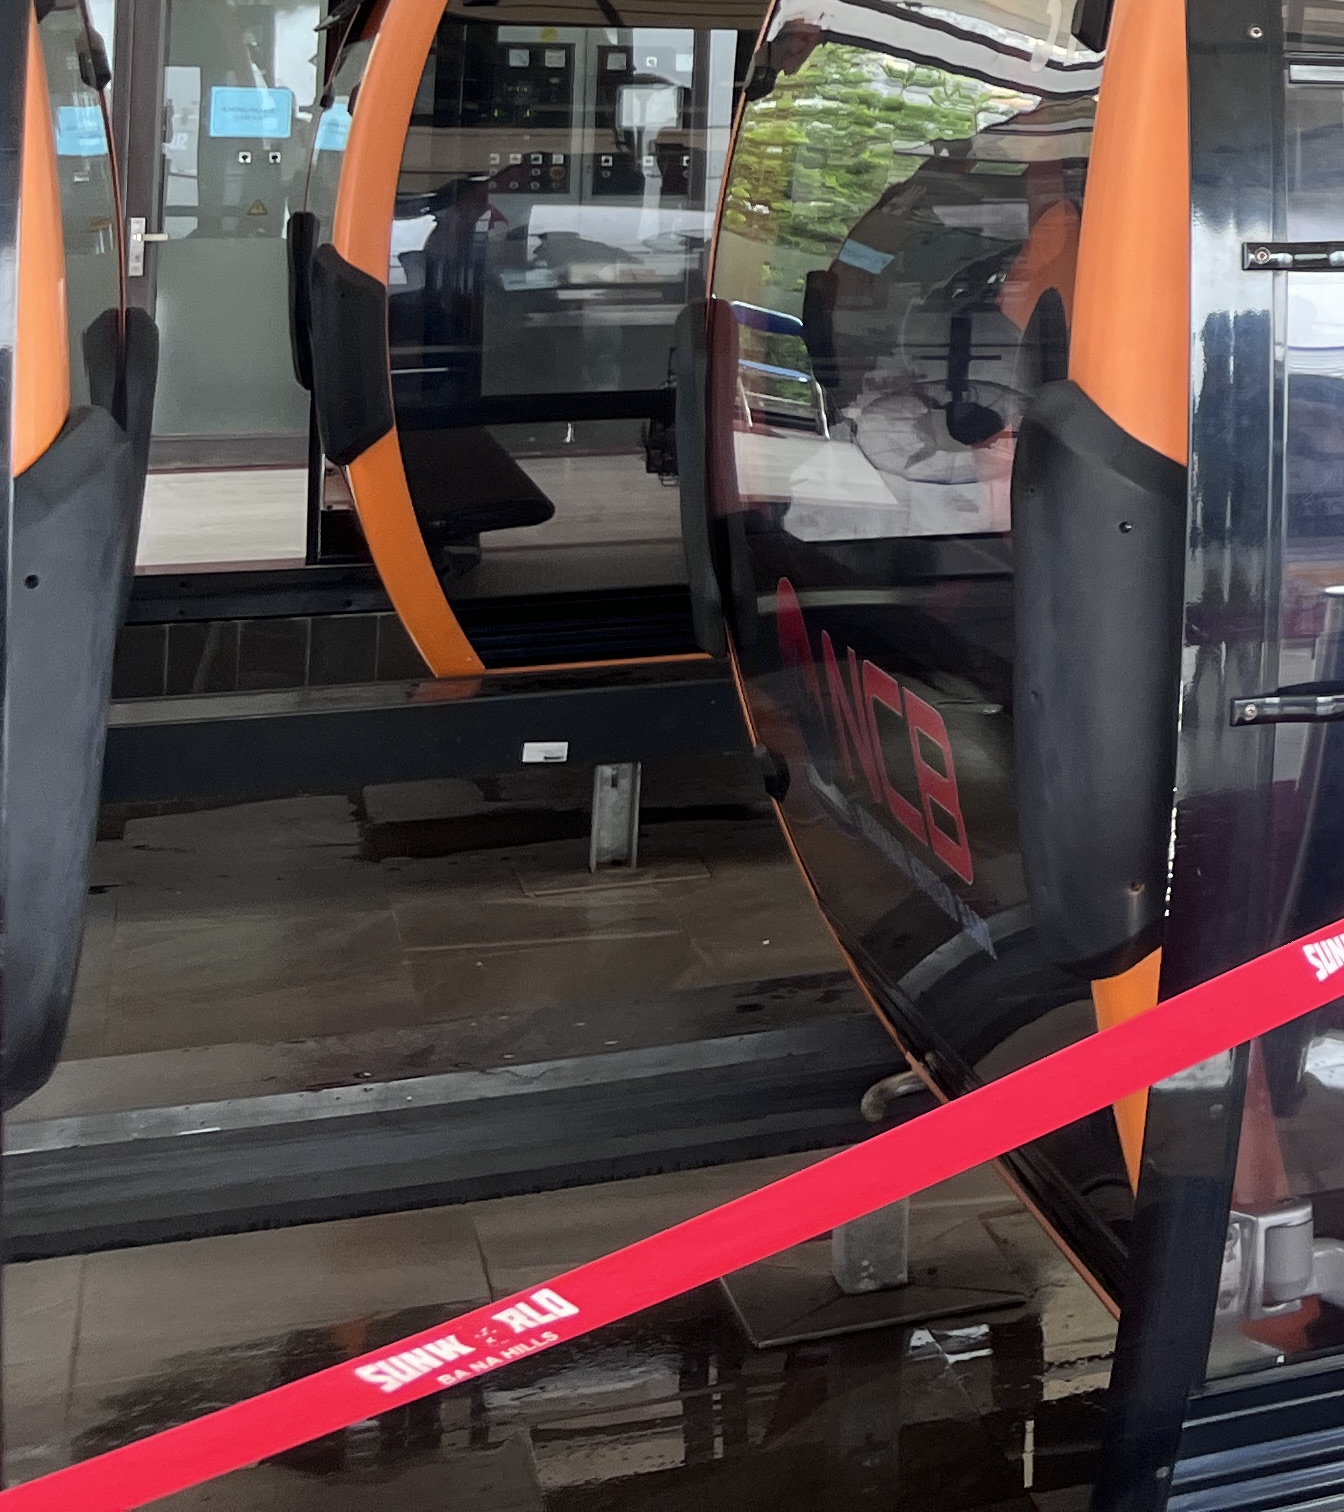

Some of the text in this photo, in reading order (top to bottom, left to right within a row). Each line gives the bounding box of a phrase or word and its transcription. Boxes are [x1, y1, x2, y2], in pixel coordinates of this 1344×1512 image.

[437, 1330, 560, 1387] BA NA HILLS
